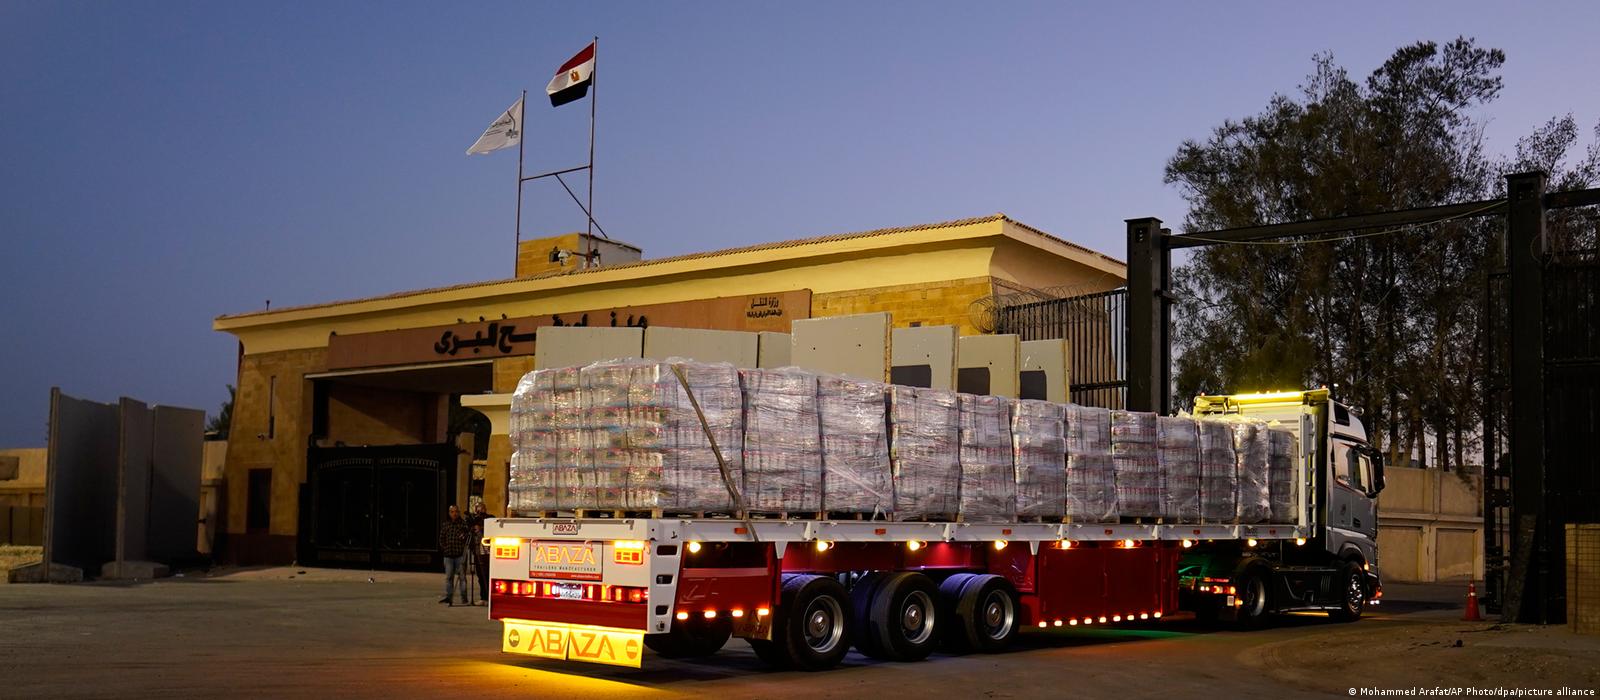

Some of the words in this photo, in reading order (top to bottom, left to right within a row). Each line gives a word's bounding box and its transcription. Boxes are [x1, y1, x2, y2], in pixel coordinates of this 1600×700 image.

[554, 524, 576, 532] ABAZA
[534, 545, 596, 565] ABAZA
[528, 628, 616, 660] ABAZA
